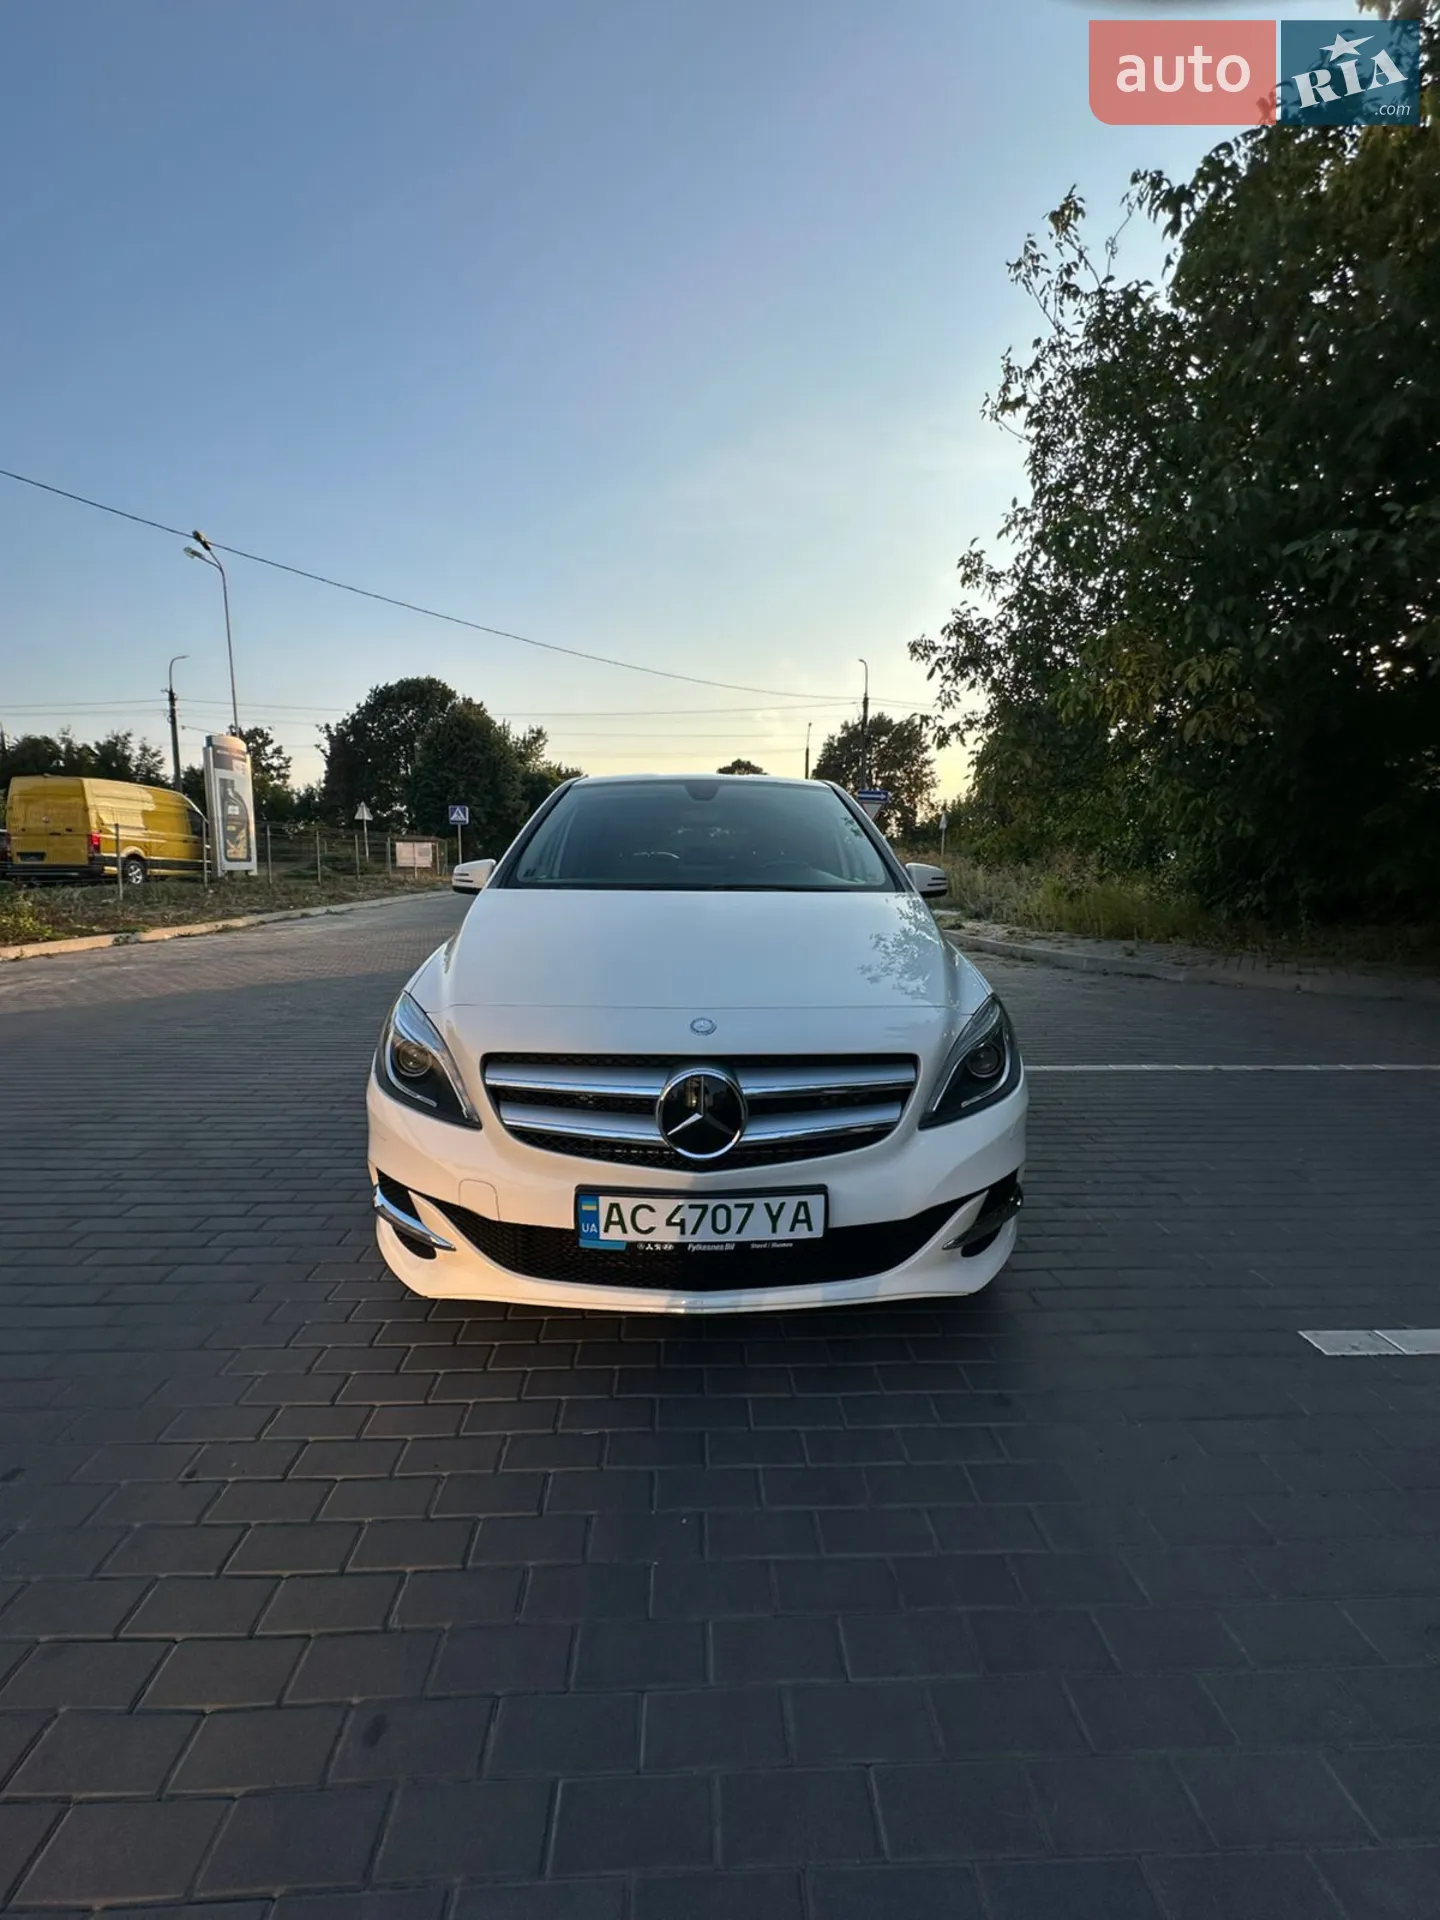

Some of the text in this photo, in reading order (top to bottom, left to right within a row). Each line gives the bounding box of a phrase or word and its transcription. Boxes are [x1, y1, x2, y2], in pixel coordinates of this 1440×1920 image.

[582, 1223, 598, 1233] UA
[603, 1202, 813, 1236] AC 4707 YA
